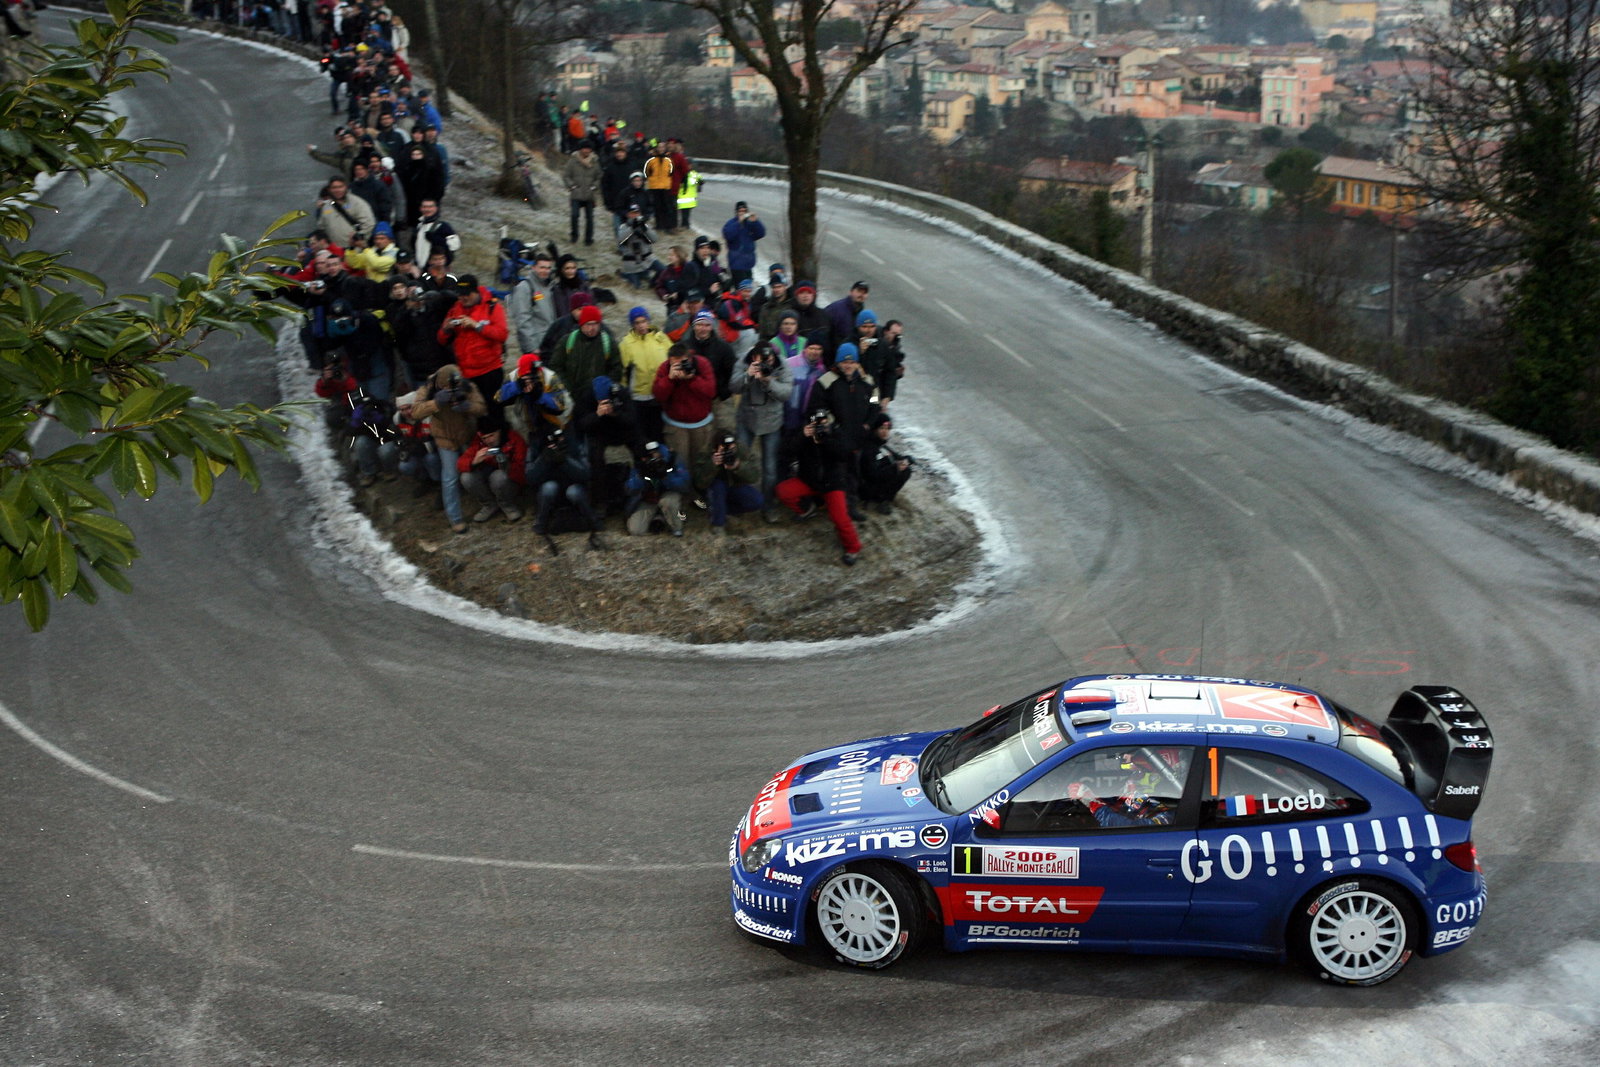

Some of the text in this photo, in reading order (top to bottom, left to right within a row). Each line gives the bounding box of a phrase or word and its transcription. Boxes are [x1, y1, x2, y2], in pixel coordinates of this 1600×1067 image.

[1137, 721, 1257, 733] kizz-me
[1207, 747, 1218, 796] 1
[754, 771, 788, 827] TOTAL
[1263, 789, 1326, 814] Loeb
[1445, 785, 1480, 795] Sabelt
[968, 789, 1009, 824] NIKKO
[827, 831, 859, 839] NATURAL
[785, 830, 916, 867] kizz-me
[963, 847, 971, 874] 1
[1004, 850, 1057, 863] 2006
[988, 853, 1073, 874] RALLYE MONTE-CARLO
[965, 890, 1079, 914] TOTAL
[734, 909, 793, 940] BFGoodrich
[968, 925, 1080, 938] BFGoodrich
